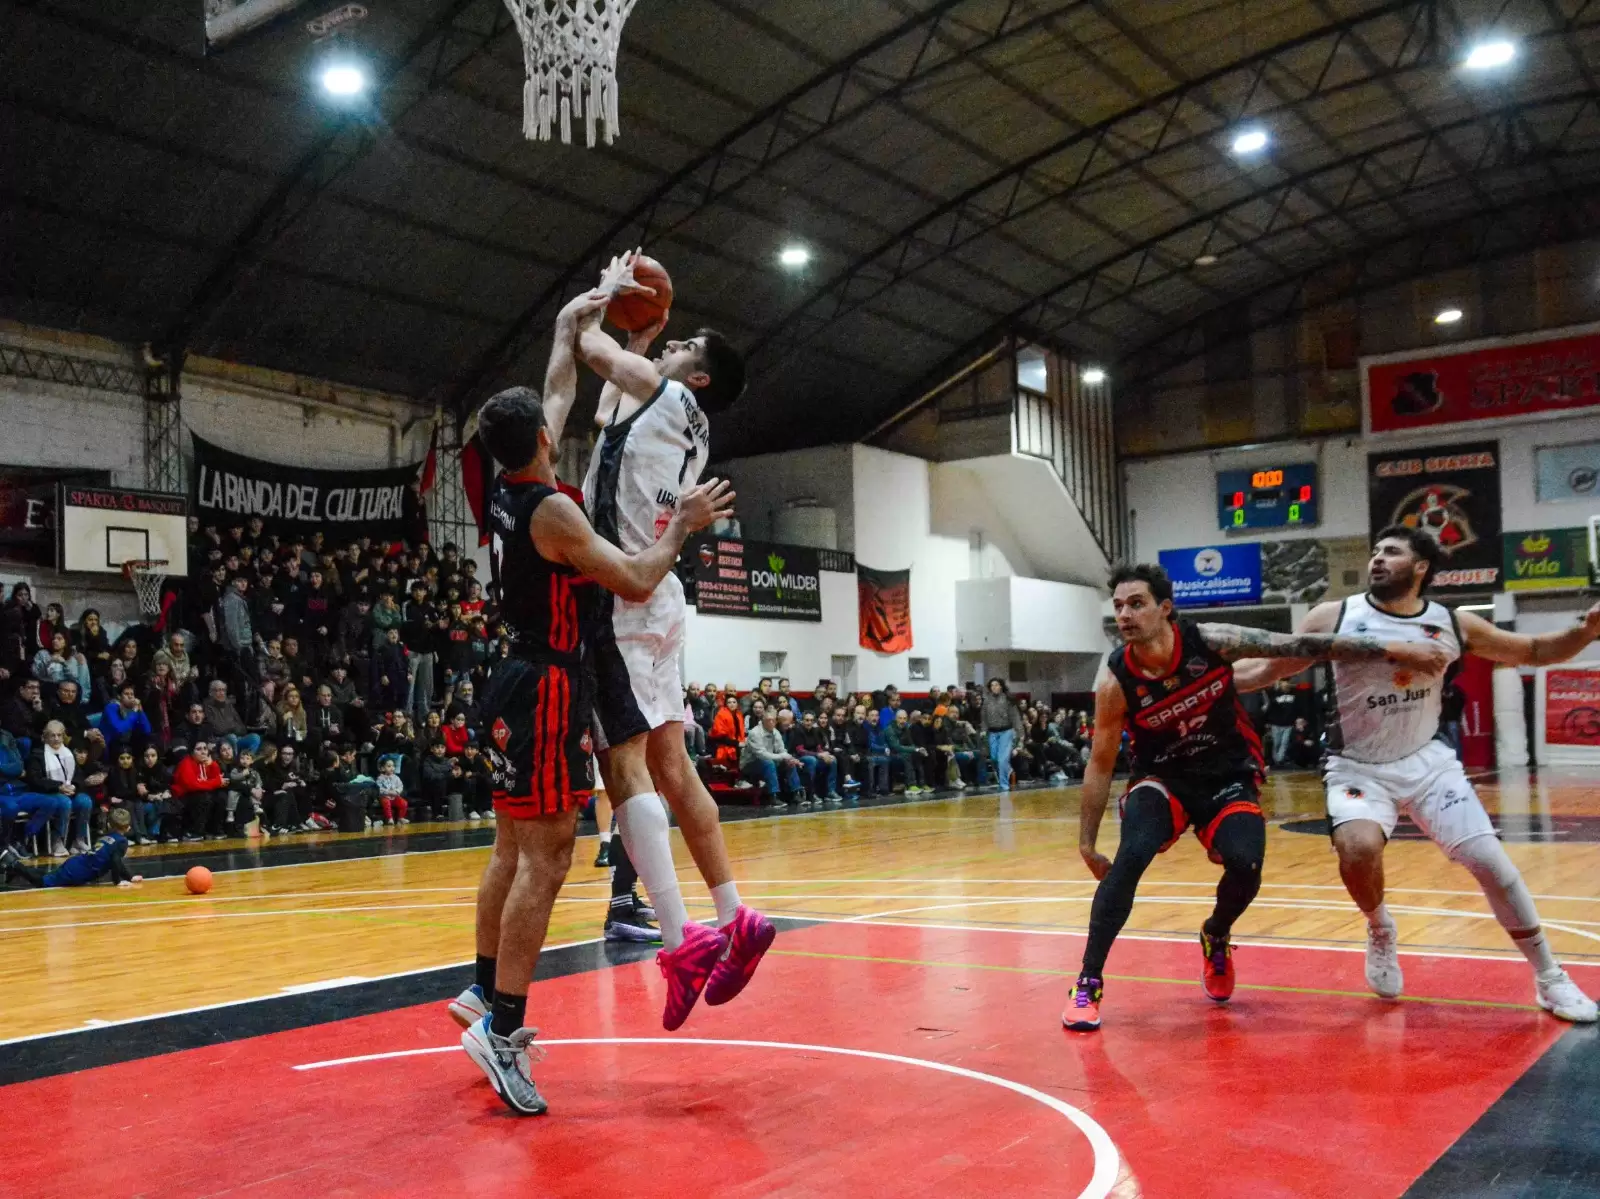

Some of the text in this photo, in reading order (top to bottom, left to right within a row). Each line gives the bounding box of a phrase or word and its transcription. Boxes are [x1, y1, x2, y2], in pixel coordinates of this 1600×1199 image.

[71, 491, 118, 508] SPARTA
[199, 465, 223, 508] LA
[225, 472, 283, 517] BANDA
[285, 483, 321, 521] DEL
[1514, 558, 1561, 577] Vida
[752, 570, 817, 591] DON WILDER
[1146, 680, 1223, 727] SPARTA
[1366, 693, 1397, 710] San
[1403, 688, 1431, 702] Juan
